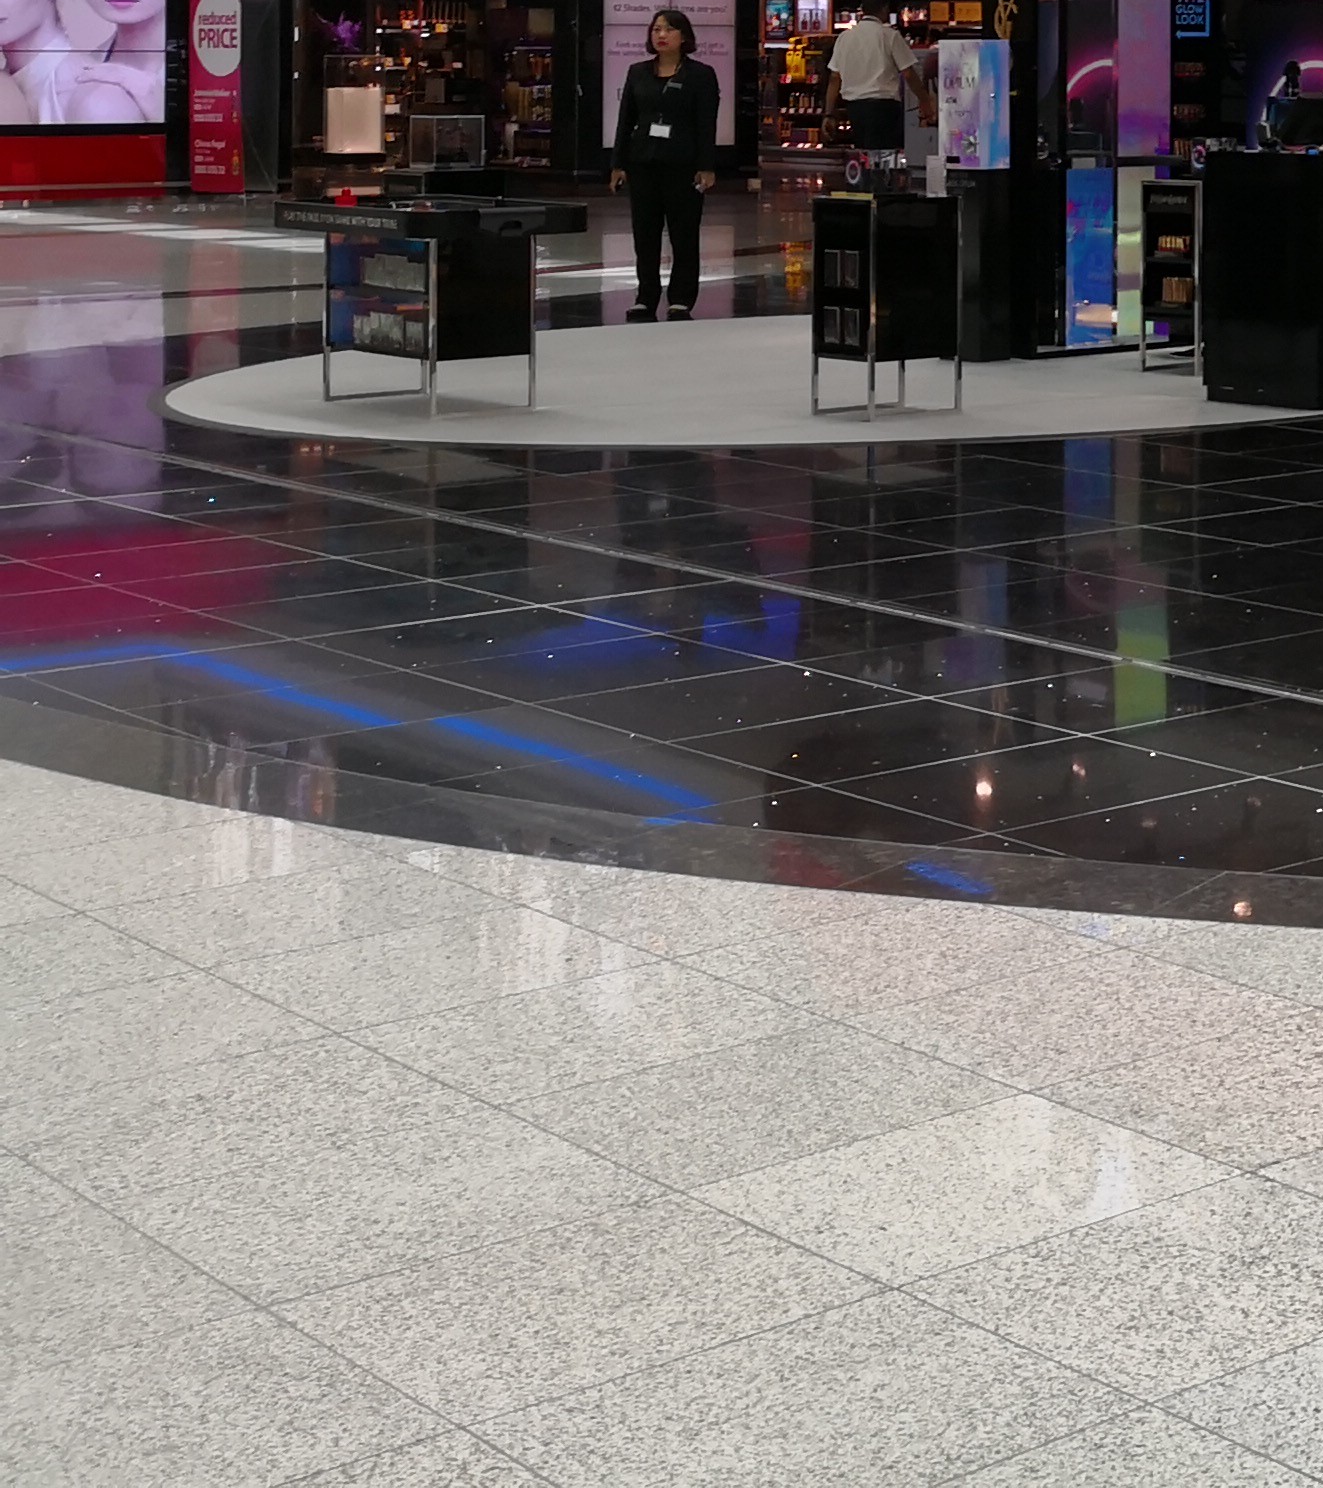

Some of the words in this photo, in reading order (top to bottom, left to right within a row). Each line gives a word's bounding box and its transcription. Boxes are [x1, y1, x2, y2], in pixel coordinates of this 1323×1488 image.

[1175, 4, 1205, 14] GLOW
[198, 10, 238, 26] reduced
[1175, 14, 1205, 25] LOOK
[198, 28, 239, 49] PRICE
